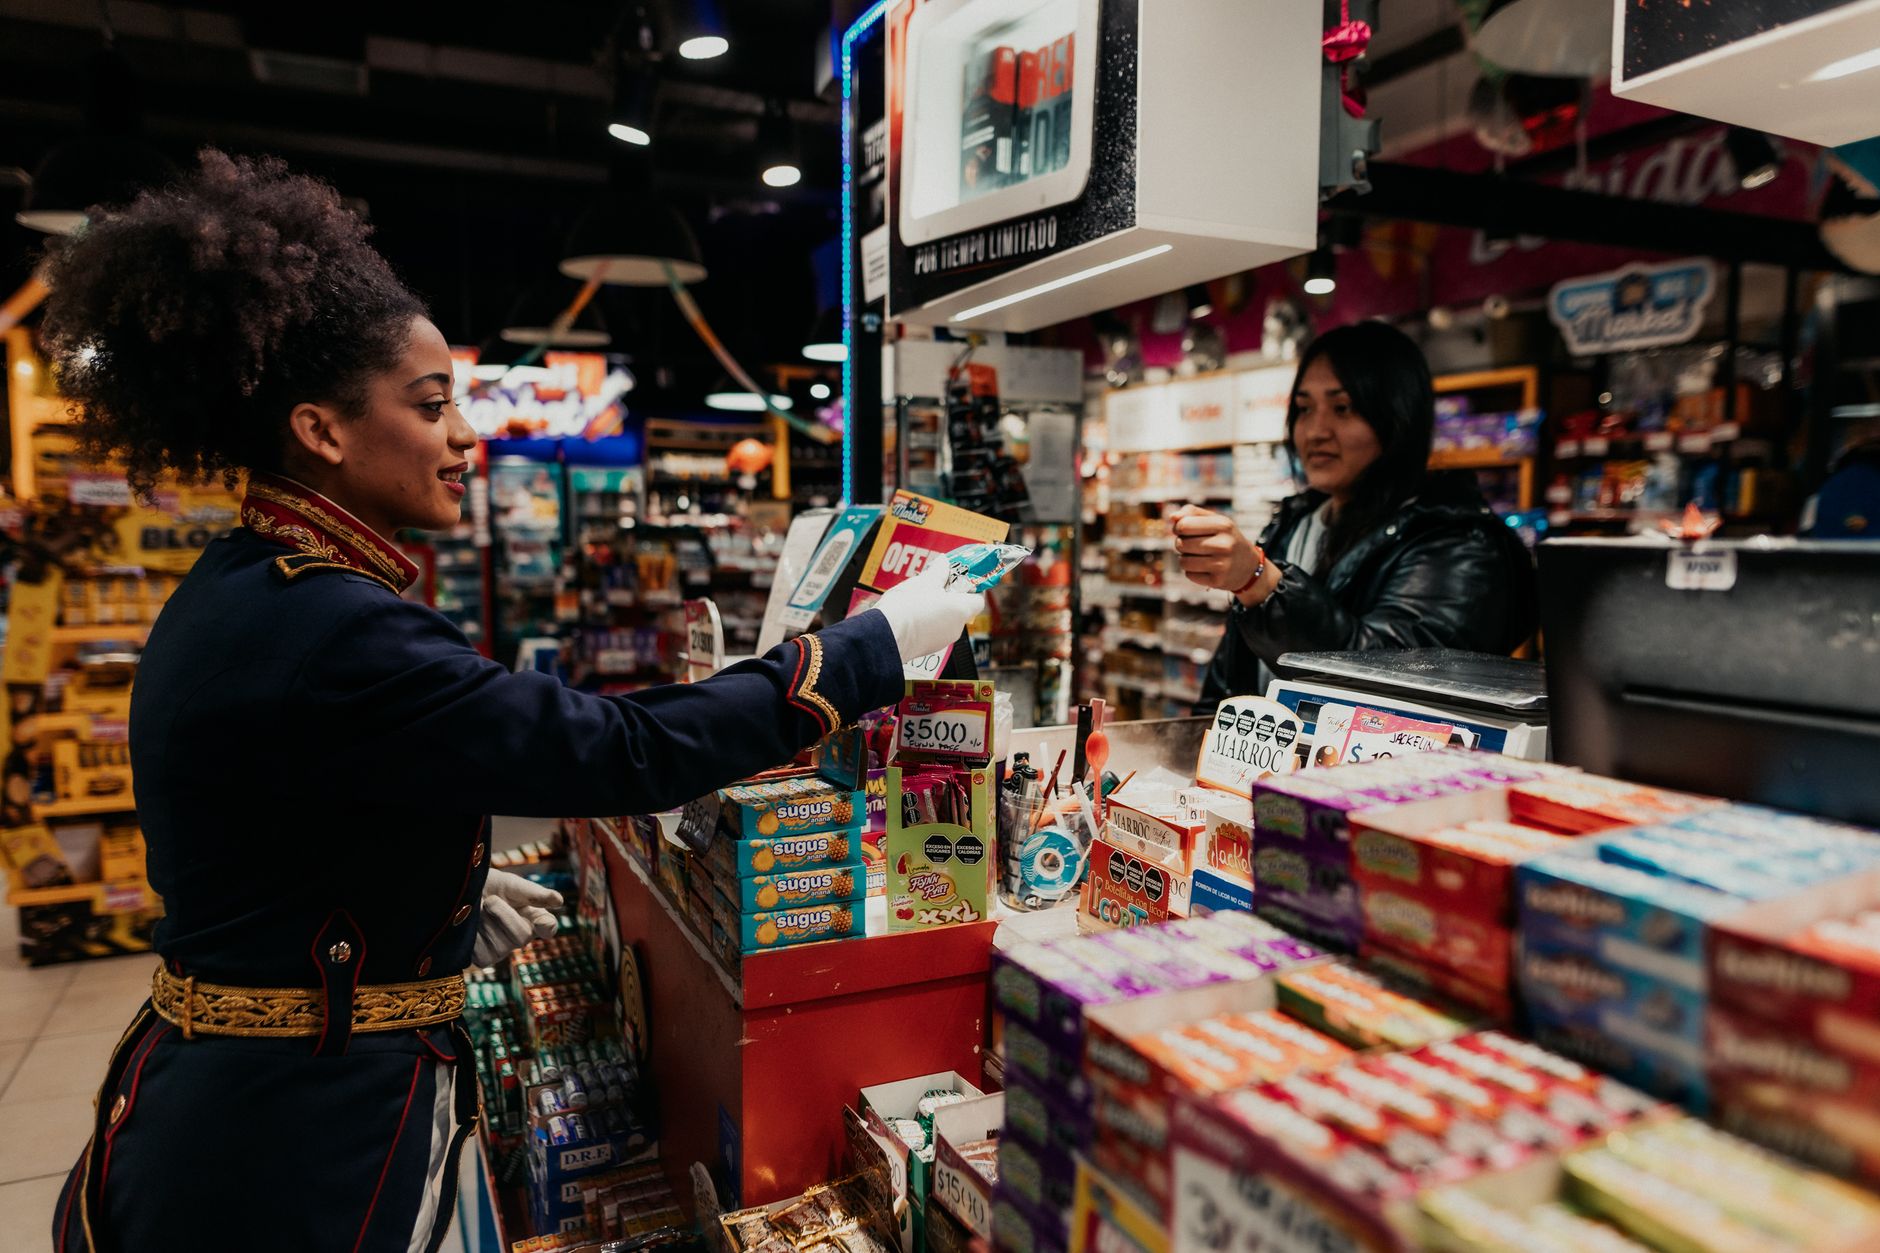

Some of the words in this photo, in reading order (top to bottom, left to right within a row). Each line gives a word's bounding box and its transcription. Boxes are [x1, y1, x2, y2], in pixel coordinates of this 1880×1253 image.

[914, 245, 937, 275] POR
[940, 232, 985, 269] TIEMPO
[988, 215, 1057, 259] LIMITADO
[892, 503, 926, 525] Market
[141, 527, 229, 550] BLO
[904, 718, 967, 744] $500
[1390, 732, 1435, 752] JACKELIN
[1212, 732, 1284, 773] MARROC
[777, 801, 832, 820] sugus
[1113, 811, 1150, 841] MARROC
[773, 838, 828, 857] sugus
[1211, 832, 1252, 874] Jackel
[776, 875, 832, 893] sugus
[1218, 890, 1230, 900] LICOR
[1105, 880, 1134, 903] Botellitas
[1135, 898, 1148, 911] con
[1149, 901, 1165, 919] licor
[776, 910, 832, 929] sugus
[917, 899, 980, 924] XXL
[565, 1148, 609, 1165] D.R.F.
